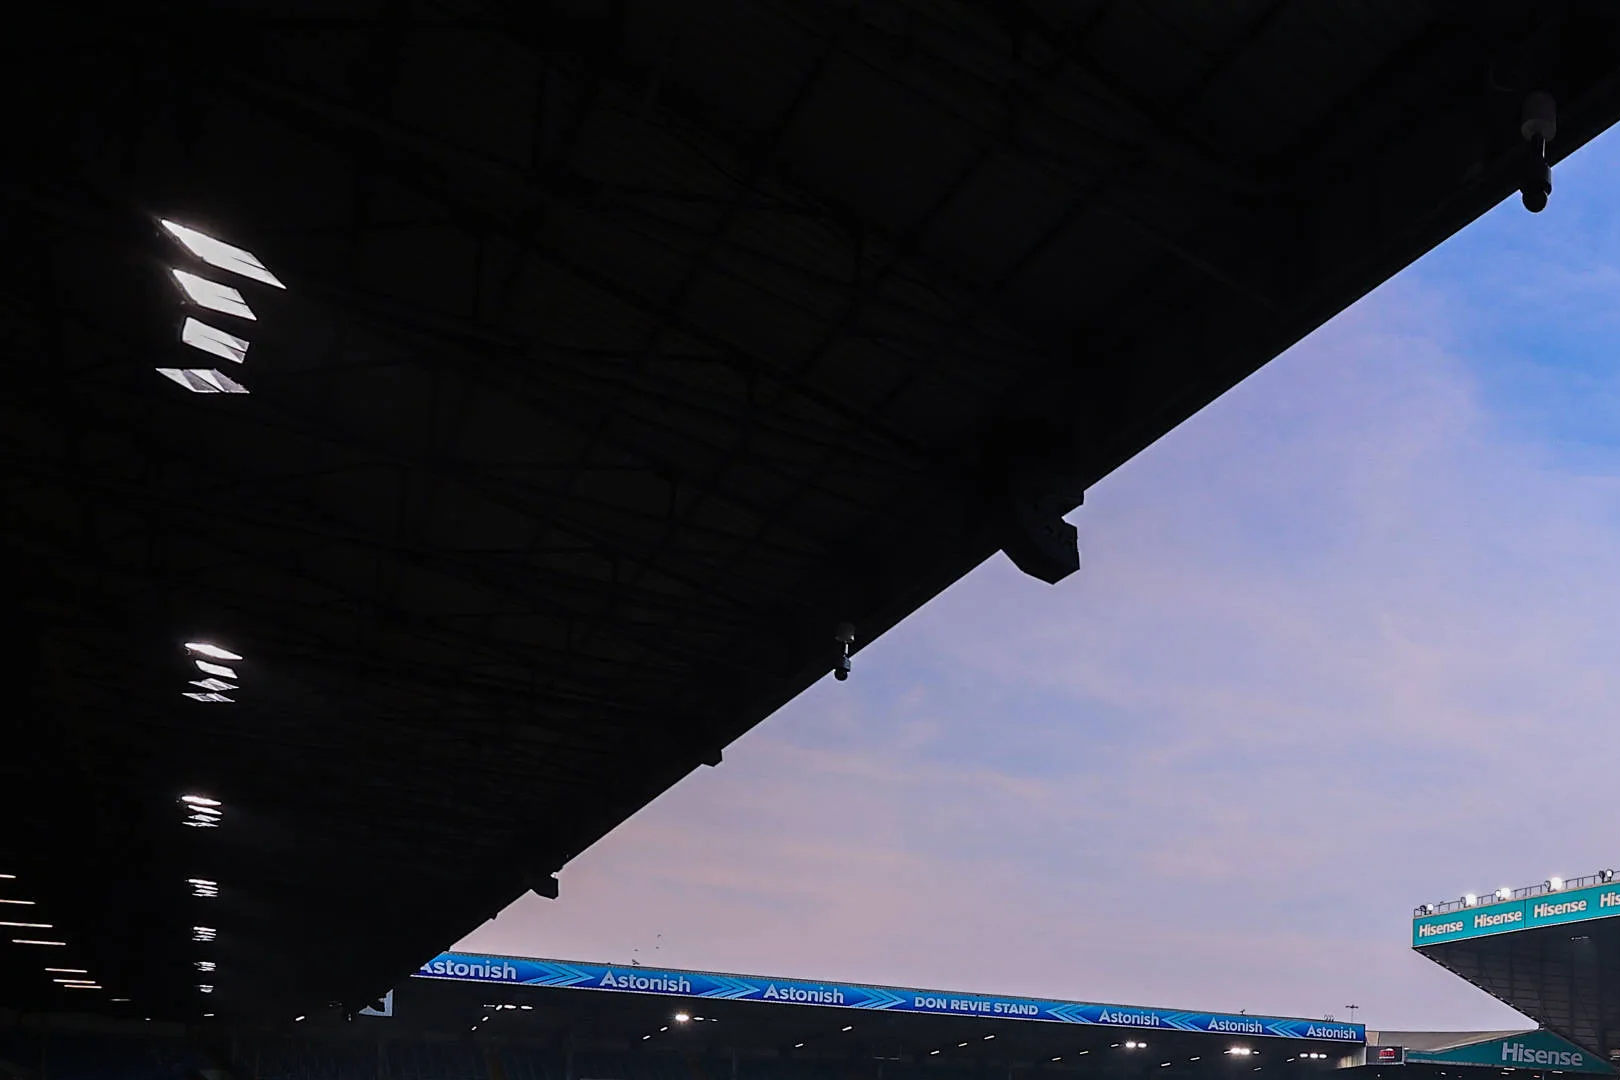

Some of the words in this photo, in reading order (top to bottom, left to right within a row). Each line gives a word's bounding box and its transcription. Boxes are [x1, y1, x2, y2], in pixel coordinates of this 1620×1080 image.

[1533, 899, 1587, 918] Hisense
[1419, 919, 1464, 938] Hisense
[1473, 909, 1522, 930] Hisense
[420, 959, 517, 980] Astonish
[600, 969, 691, 995] Astonish
[764, 983, 844, 1005] Astonish
[914, 995, 948, 1009] DON
[951, 998, 991, 1013] REVIE
[994, 1001, 1038, 1016] STAND
[1098, 1009, 1159, 1027] Astonish
[1208, 1017, 1263, 1034] Astonish
[1306, 1024, 1356, 1039] Astonish
[1501, 1041, 1583, 1067] Hisense
